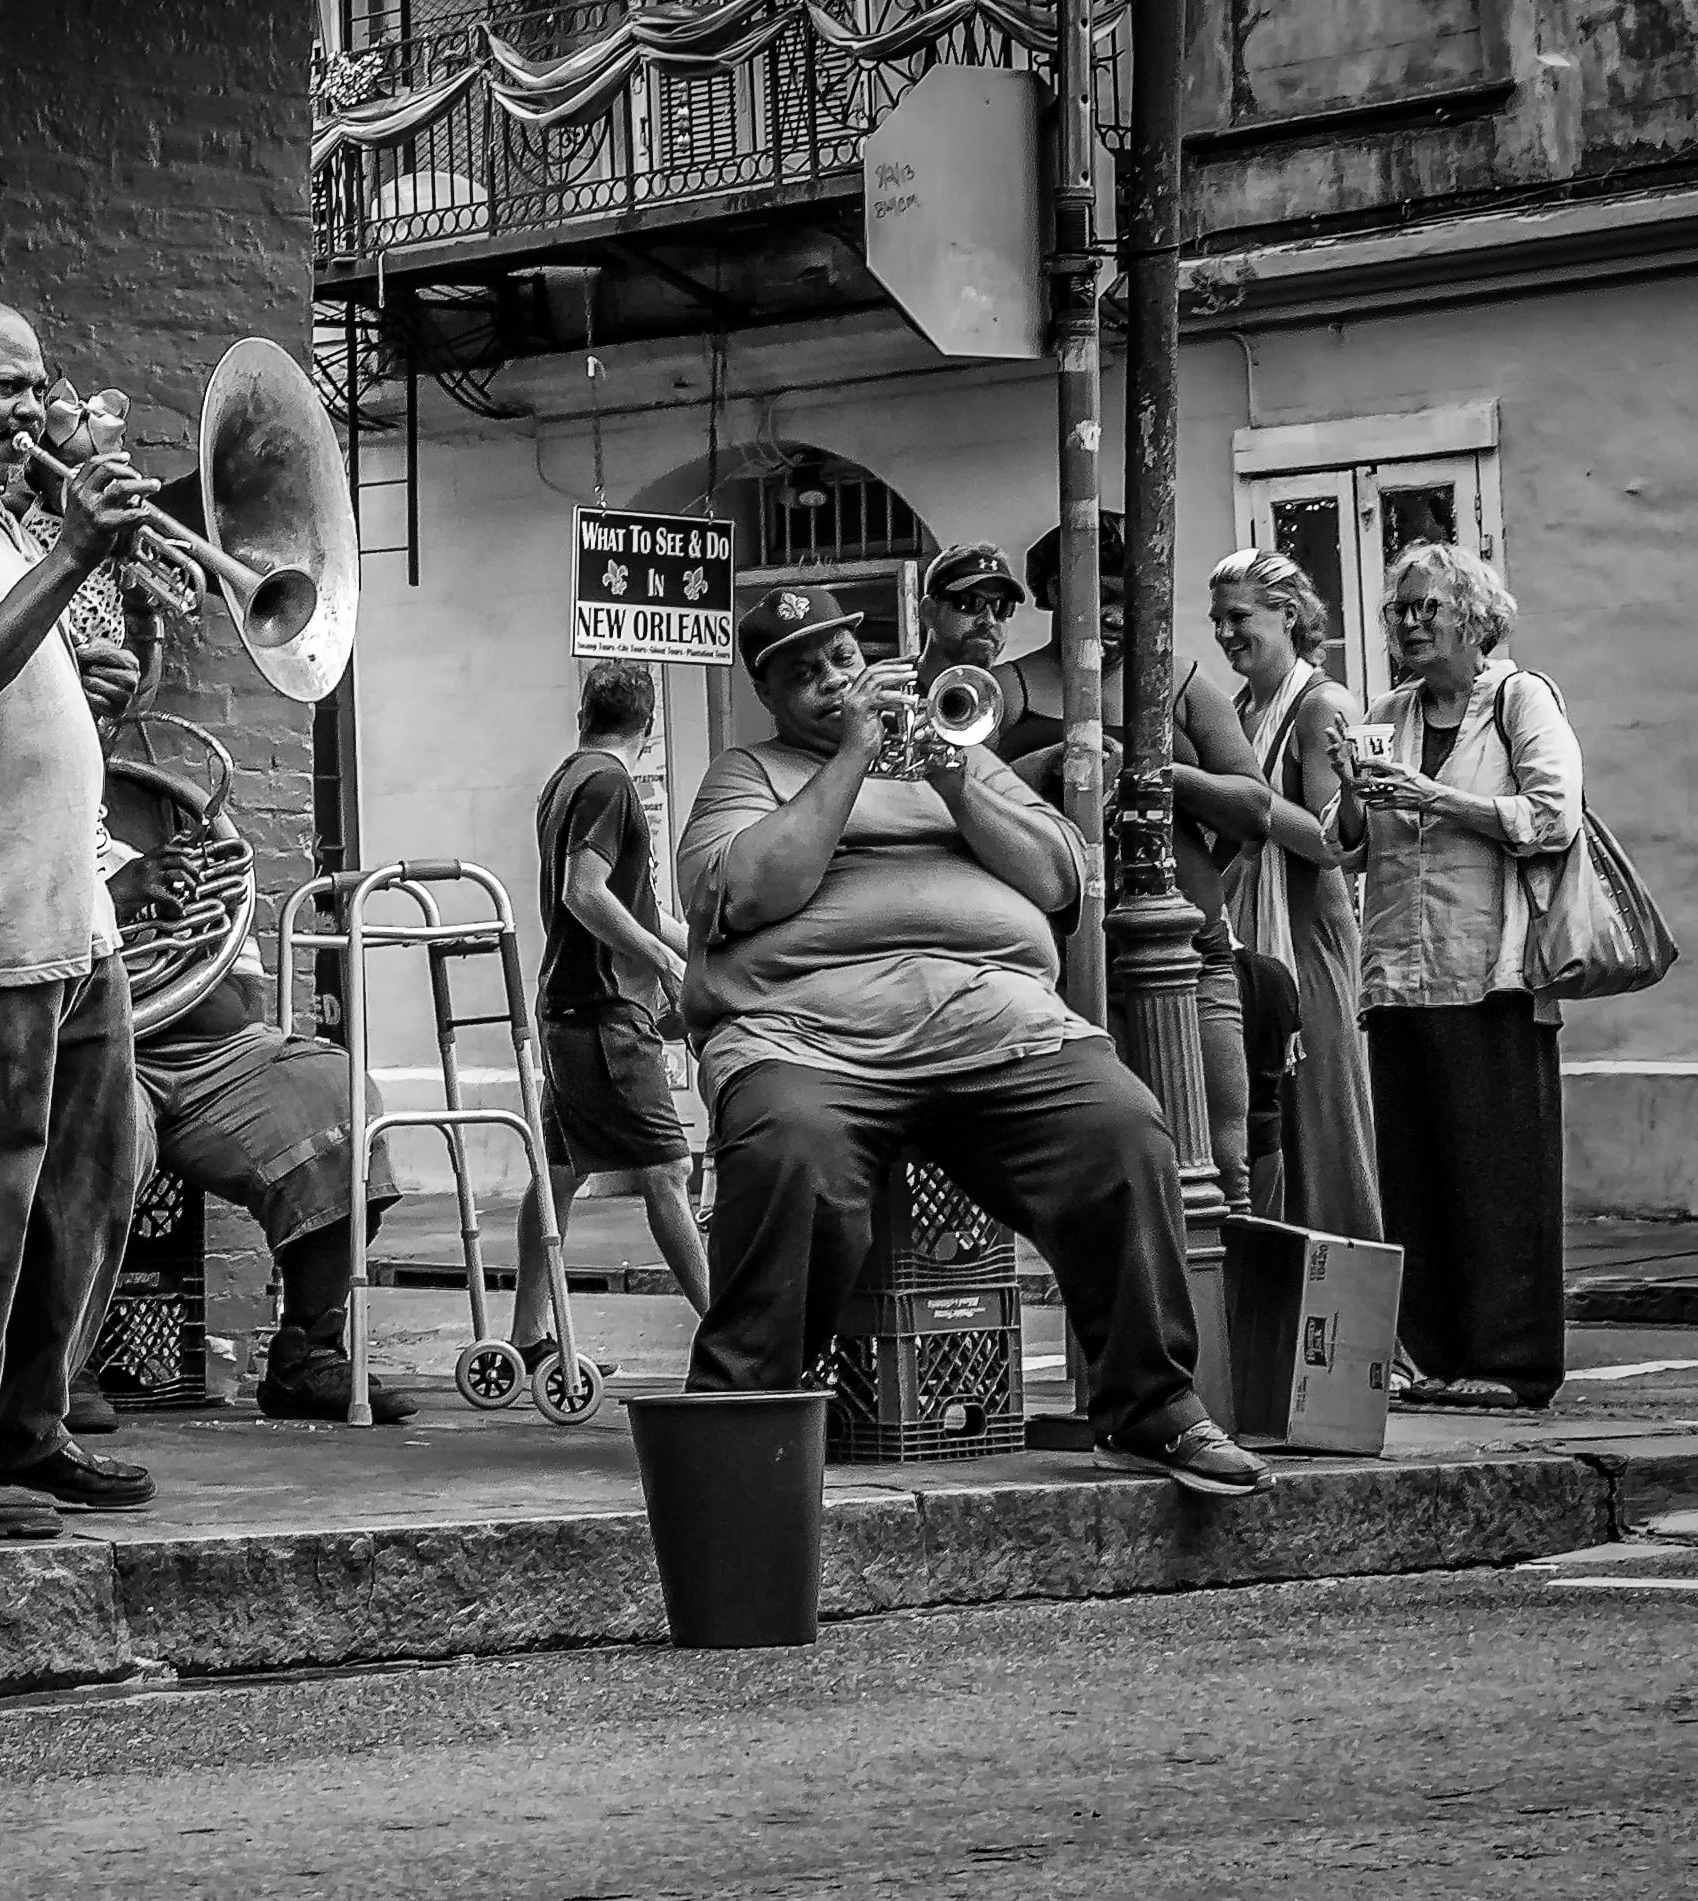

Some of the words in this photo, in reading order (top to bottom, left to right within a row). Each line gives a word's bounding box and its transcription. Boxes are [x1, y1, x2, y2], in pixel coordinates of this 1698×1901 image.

[581, 520, 626, 552] WHAT
[629, 525, 652, 554] TO
[655, 527, 685, 557] SEE
[688, 529, 702, 559] &
[706, 531, 729, 560] DO
[647, 568, 665, 598] IN
[577, 606, 626, 639] NEW
[633, 610, 731, 647] ORLEANS
